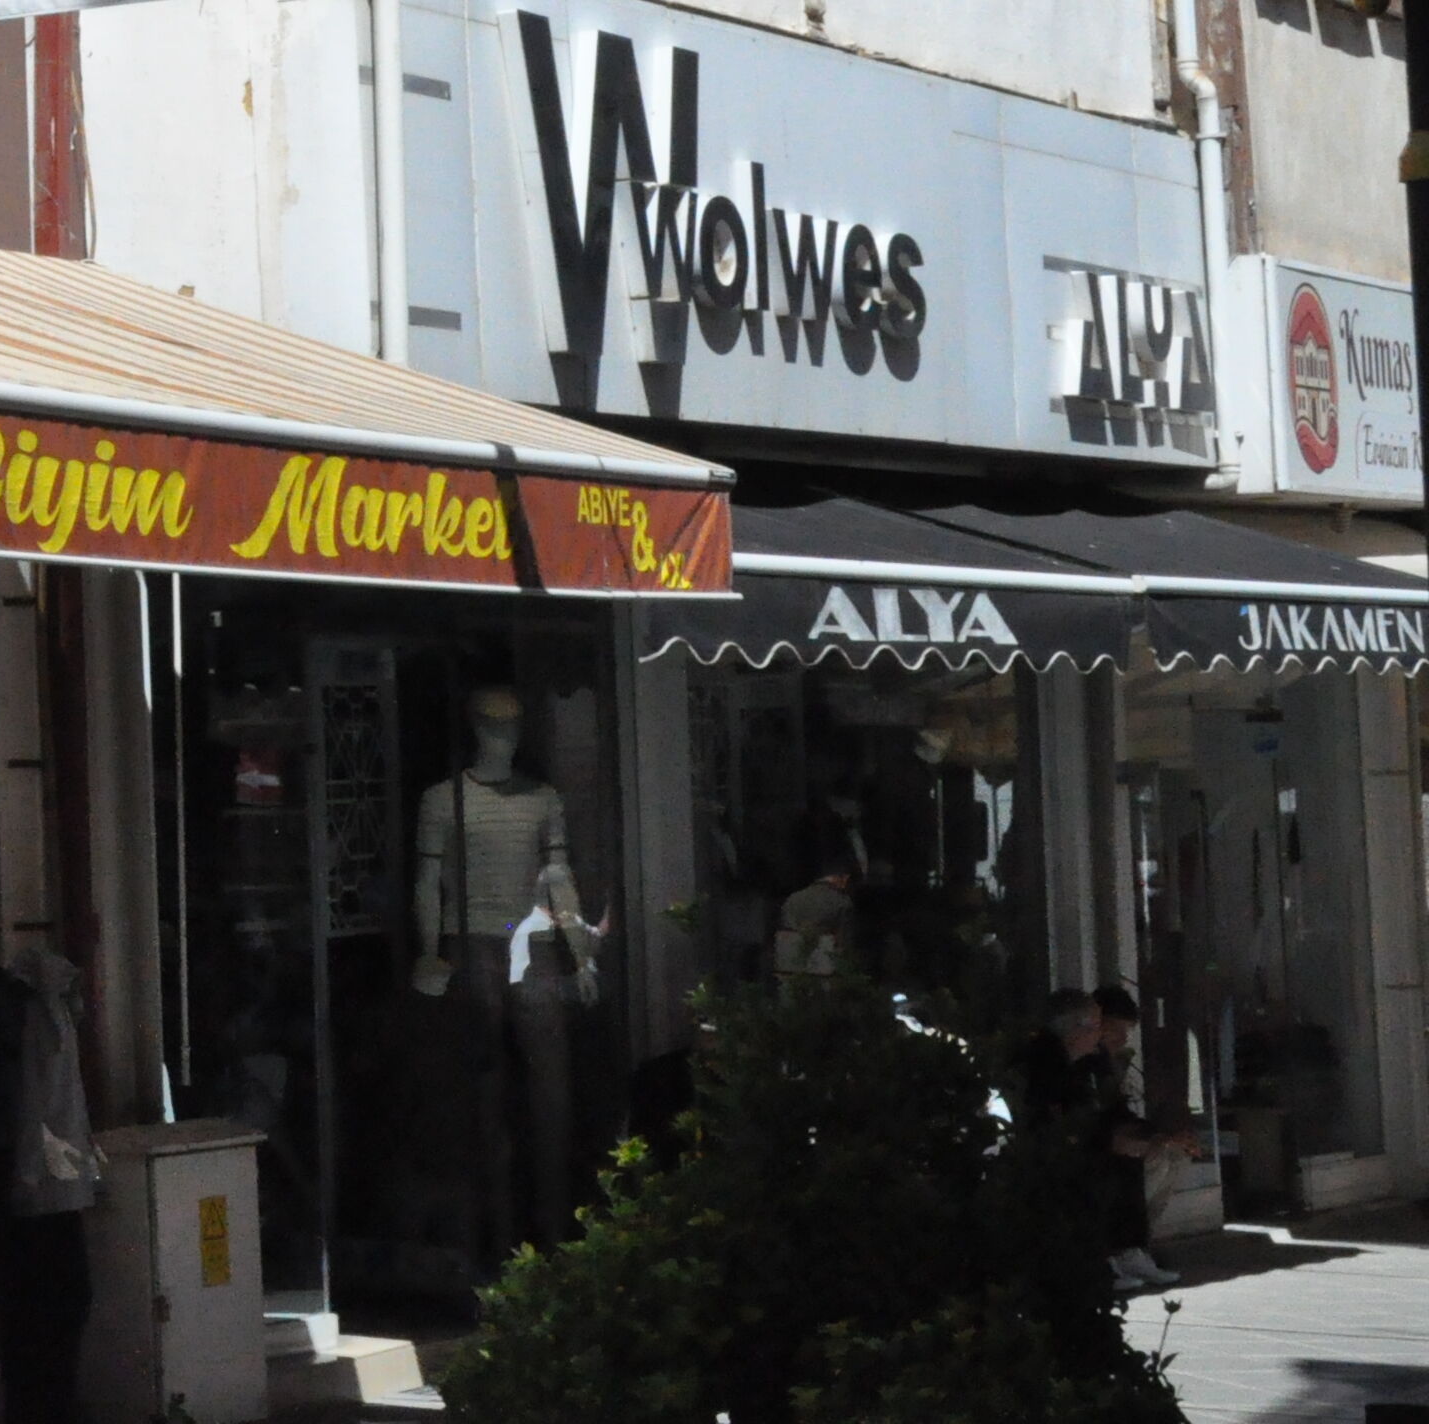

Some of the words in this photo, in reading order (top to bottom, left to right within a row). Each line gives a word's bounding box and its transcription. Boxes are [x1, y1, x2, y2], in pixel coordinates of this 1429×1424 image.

[1339, 308, 1414, 414] Kumaş
[631, 500, 658, 572] &
[808, 585, 1019, 646] ALYA
[1238, 603, 1426, 654] JAKAMEN
